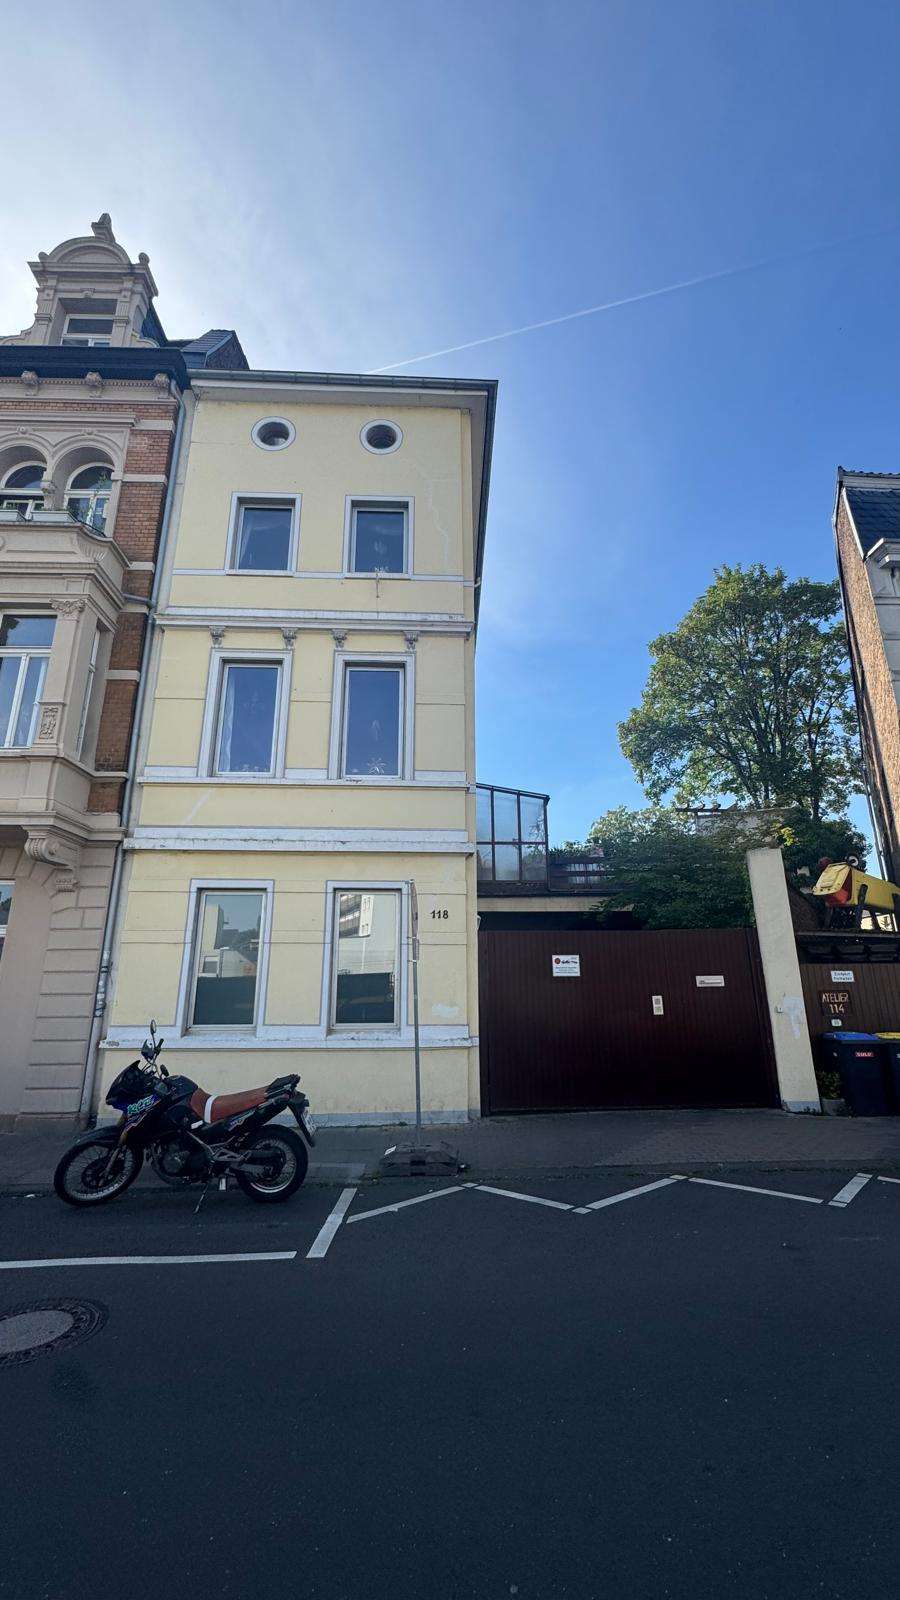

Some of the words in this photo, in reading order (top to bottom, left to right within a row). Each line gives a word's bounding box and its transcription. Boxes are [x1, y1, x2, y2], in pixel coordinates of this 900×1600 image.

[430, 909, 449, 920] 118
[822, 992, 849, 1003] ATELIER
[830, 1003, 845, 1014] 114
